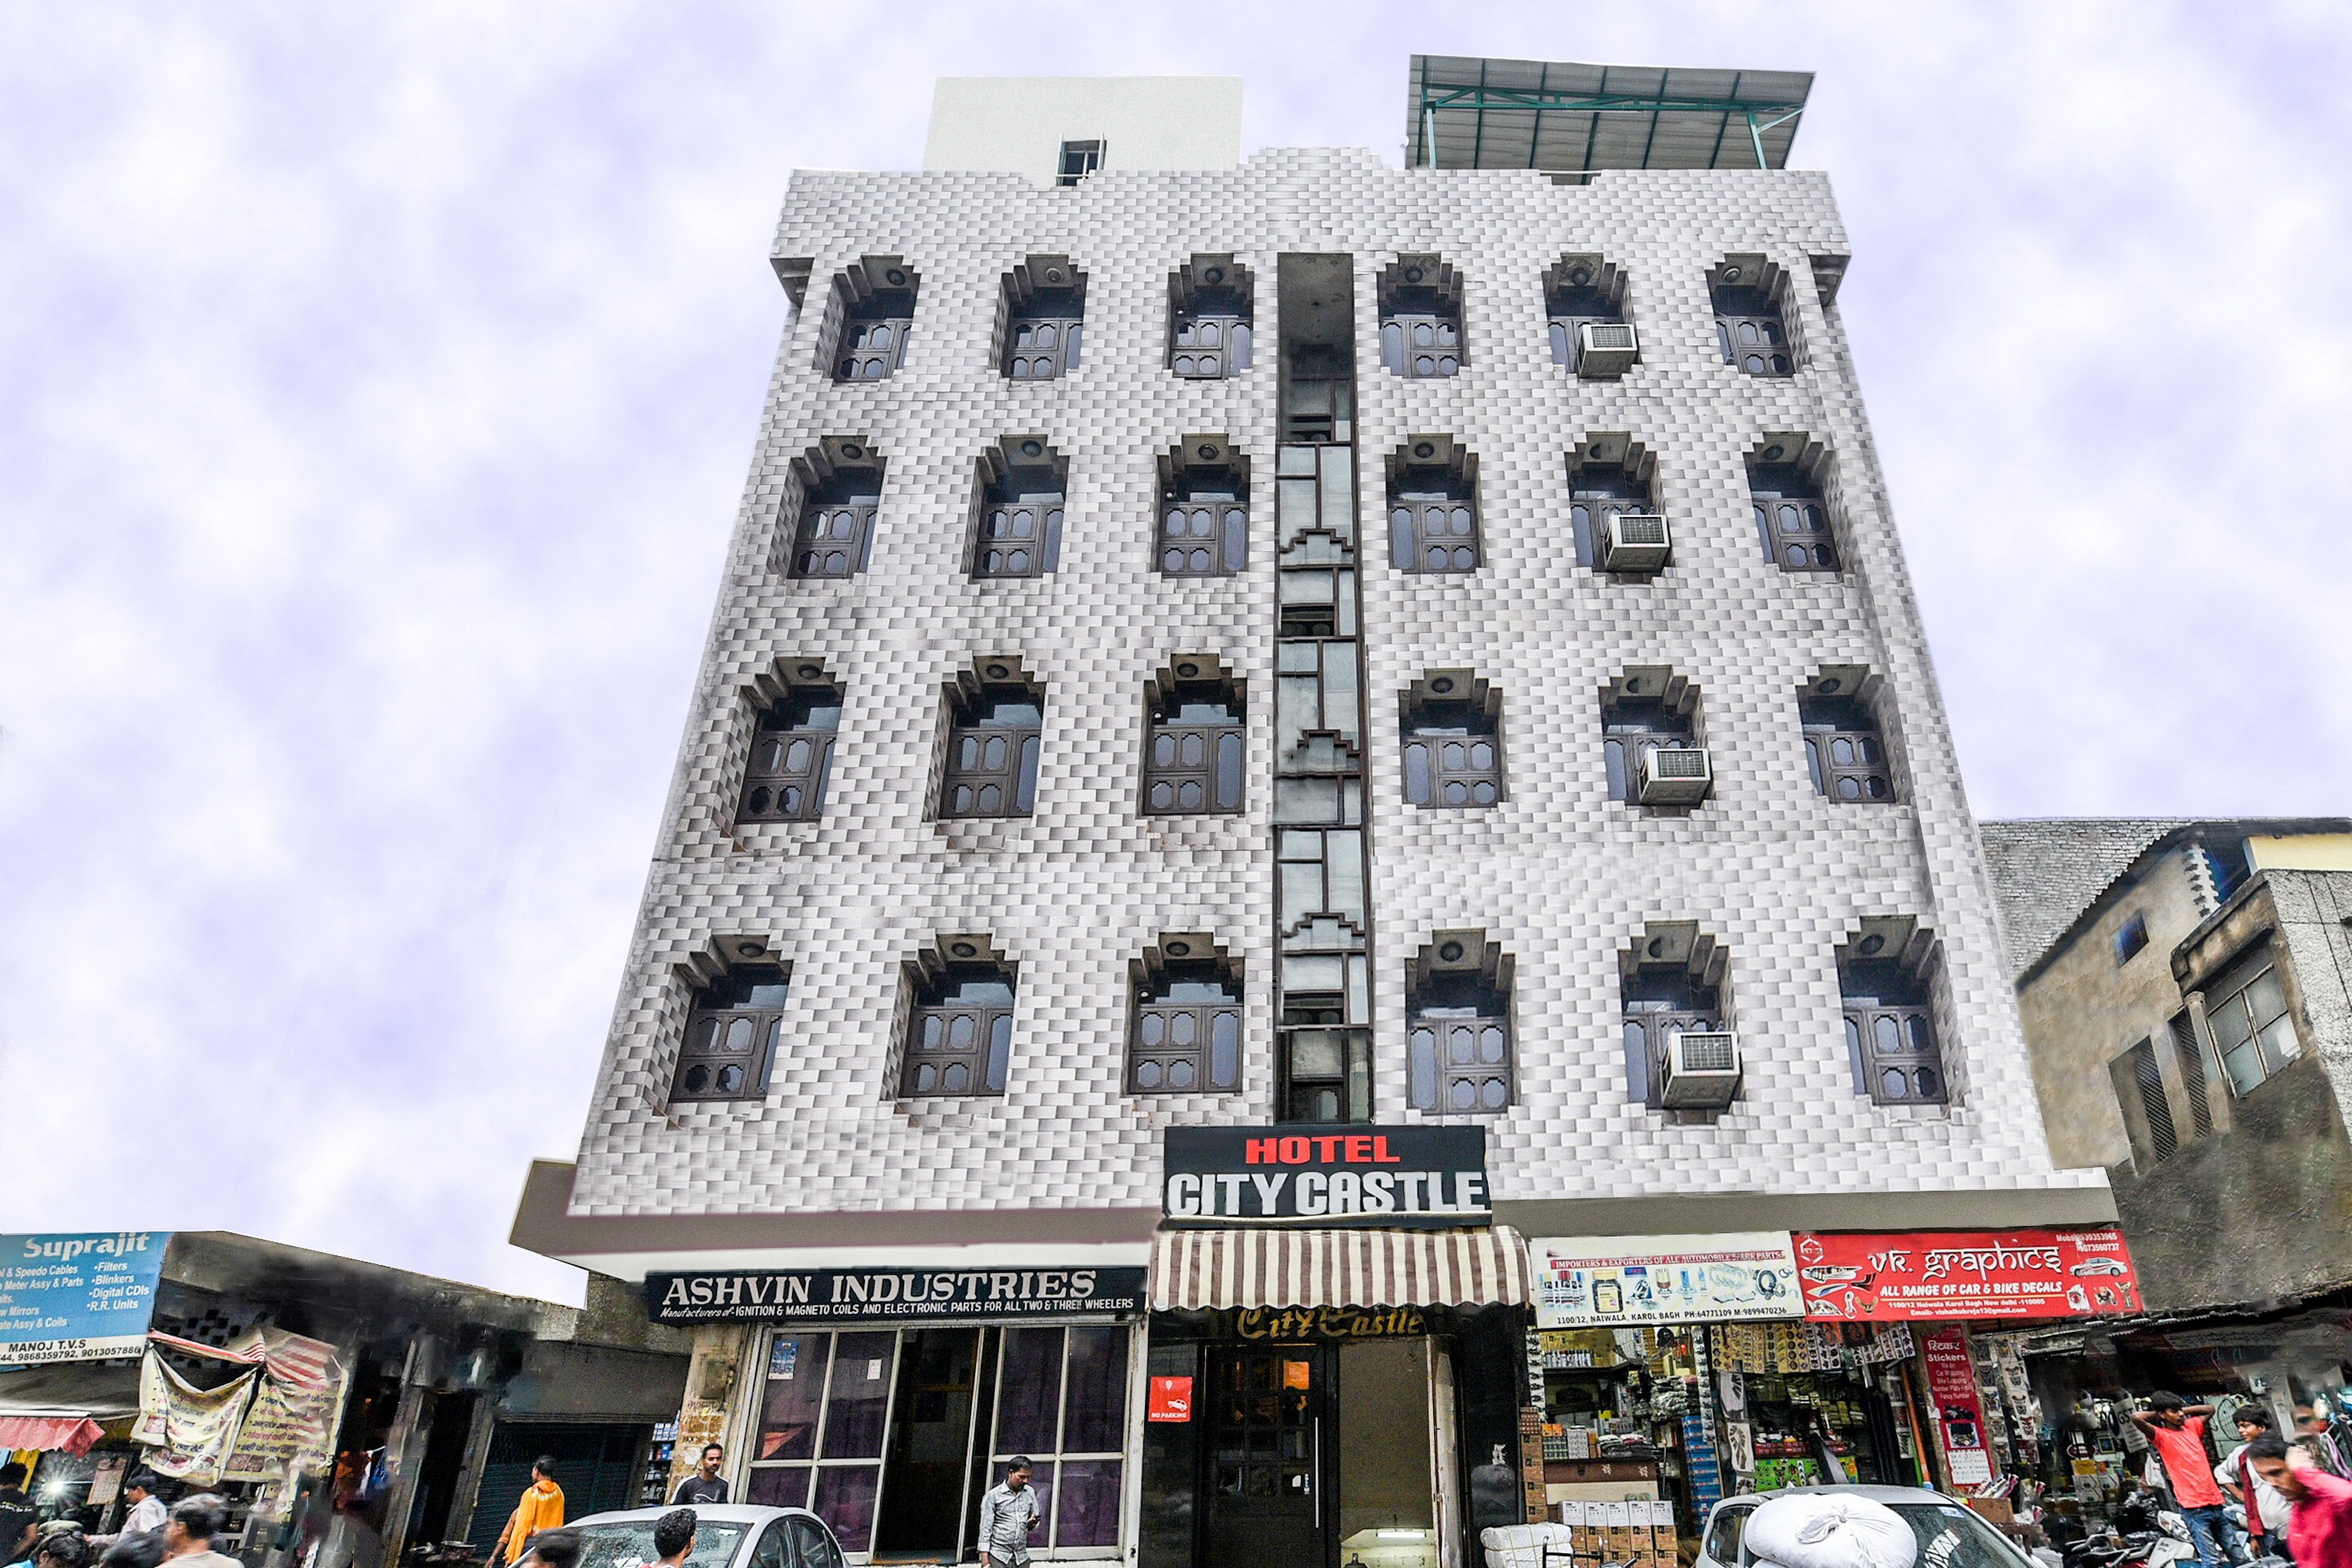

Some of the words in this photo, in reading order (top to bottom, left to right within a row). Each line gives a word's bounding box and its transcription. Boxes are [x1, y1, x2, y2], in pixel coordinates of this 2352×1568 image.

[1245, 1136, 1401, 1164] HOTEL
[1168, 1173, 1288, 1216] CITY
[1295, 1171, 1486, 1215] CASTLE
[24, 1232, 149, 1261] Suprajit
[97, 1262, 127, 1272] Filters
[1556, 1259, 1601, 1268] IMPORTERS
[1609, 1257, 1654, 1266] EXPORTERS
[1655, 1256, 1664, 1264] OF
[1922, 1240, 2062, 1282] graphics
[7, 1267, 13, 1277] &
[15, 1266, 47, 1279] Speedo
[49, 1265, 78, 1275] Cables
[4, 1280, 29, 1290] Meter
[29, 1279, 51, 1291] Assy
[53, 1278, 60, 1288] &
[61, 1276, 83, 1287] Parts
[95, 1274, 134, 1285] Blinkers
[92, 1286, 123, 1299] Digital
[126, 1285, 149, 1296] CDIs
[662, 1276, 811, 1305] ASHVIN
[831, 1270, 1097, 1303] INDUSTRIES
[1880, 1285, 1900, 1296] ALL
[1902, 1285, 1940, 1297] RANGE
[1942, 1284, 1957, 1295] OF
[1959, 1284, 1980, 1294] CAR
[1984, 1283, 1991, 1294] &
[1993, 1282, 2020, 1294] BIKE
[2022, 1281, 2062, 1293] DECALS
[9, 1306, 39, 1316] Mirrors
[90, 1300, 110, 1312] R.R.
[114, 1299, 139, 1310] Units
[661, 1307, 721, 1317] Manufacturers
[736, 1305, 775, 1316] IGNITION
[777, 1306, 783, 1316] &
[786, 1304, 830, 1316] MAGNETO
[832, 1304, 859, 1314] COILS
[862, 1303, 880, 1314] AND
[884, 1302, 947, 1313] ELECTRONIC
[951, 1301, 981, 1312] PARTS
[984, 1301, 1002, 1312] FOR
[1004, 1300, 1021, 1311] ALL
[1023, 1300, 1042, 1310] TWO
[1045, 1300, 1051, 1310] &
[1085, 1298, 1134, 1309] WHEELERS
[12, 1319, 34, 1331] Assy
[37, 1317, 43, 1328] &
[45, 1316, 67, 1327] Coils
[1238, 1308, 1315, 1339] City
[1319, 1307, 1424, 1337] Castle
[1632, 1312, 1657, 1321] KAROL
[8, 1342, 53, 1352] MANOJ
[58, 1339, 86, 1349] T.V.S
[18, 1350, 78, 1361] 9868359792,
[1928, 1353, 1966, 1362] Stickers
